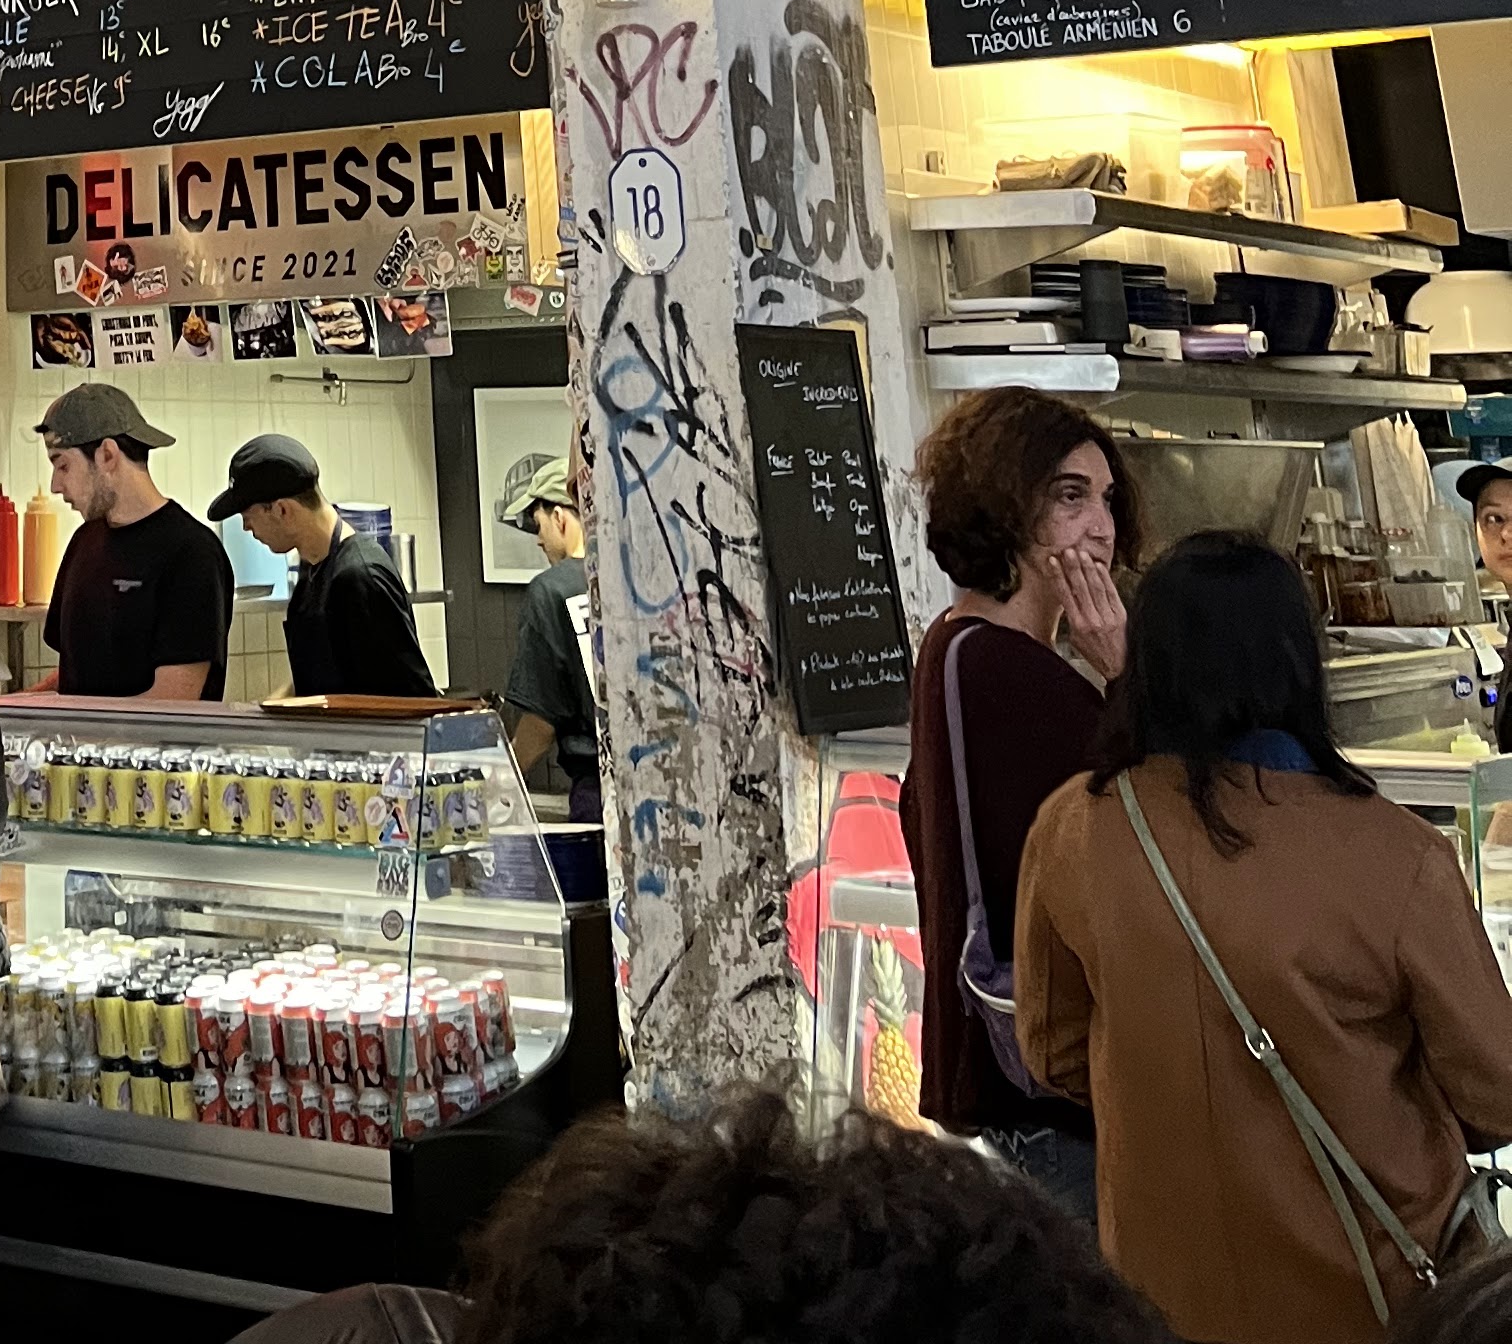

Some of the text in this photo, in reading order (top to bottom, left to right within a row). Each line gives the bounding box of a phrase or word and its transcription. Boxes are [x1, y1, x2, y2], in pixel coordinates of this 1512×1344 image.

[269, 10, 329, 45] ICE
[1173, 9, 1192, 33] 6
[137, 29, 169, 57] XL
[274, 50, 384, 90] COLA
[10, 73, 90, 117] CHEESE
[46, 132, 507, 245] DELICATESSEN
[627, 184, 665, 241] 18
[281, 248, 357, 281] 2021
